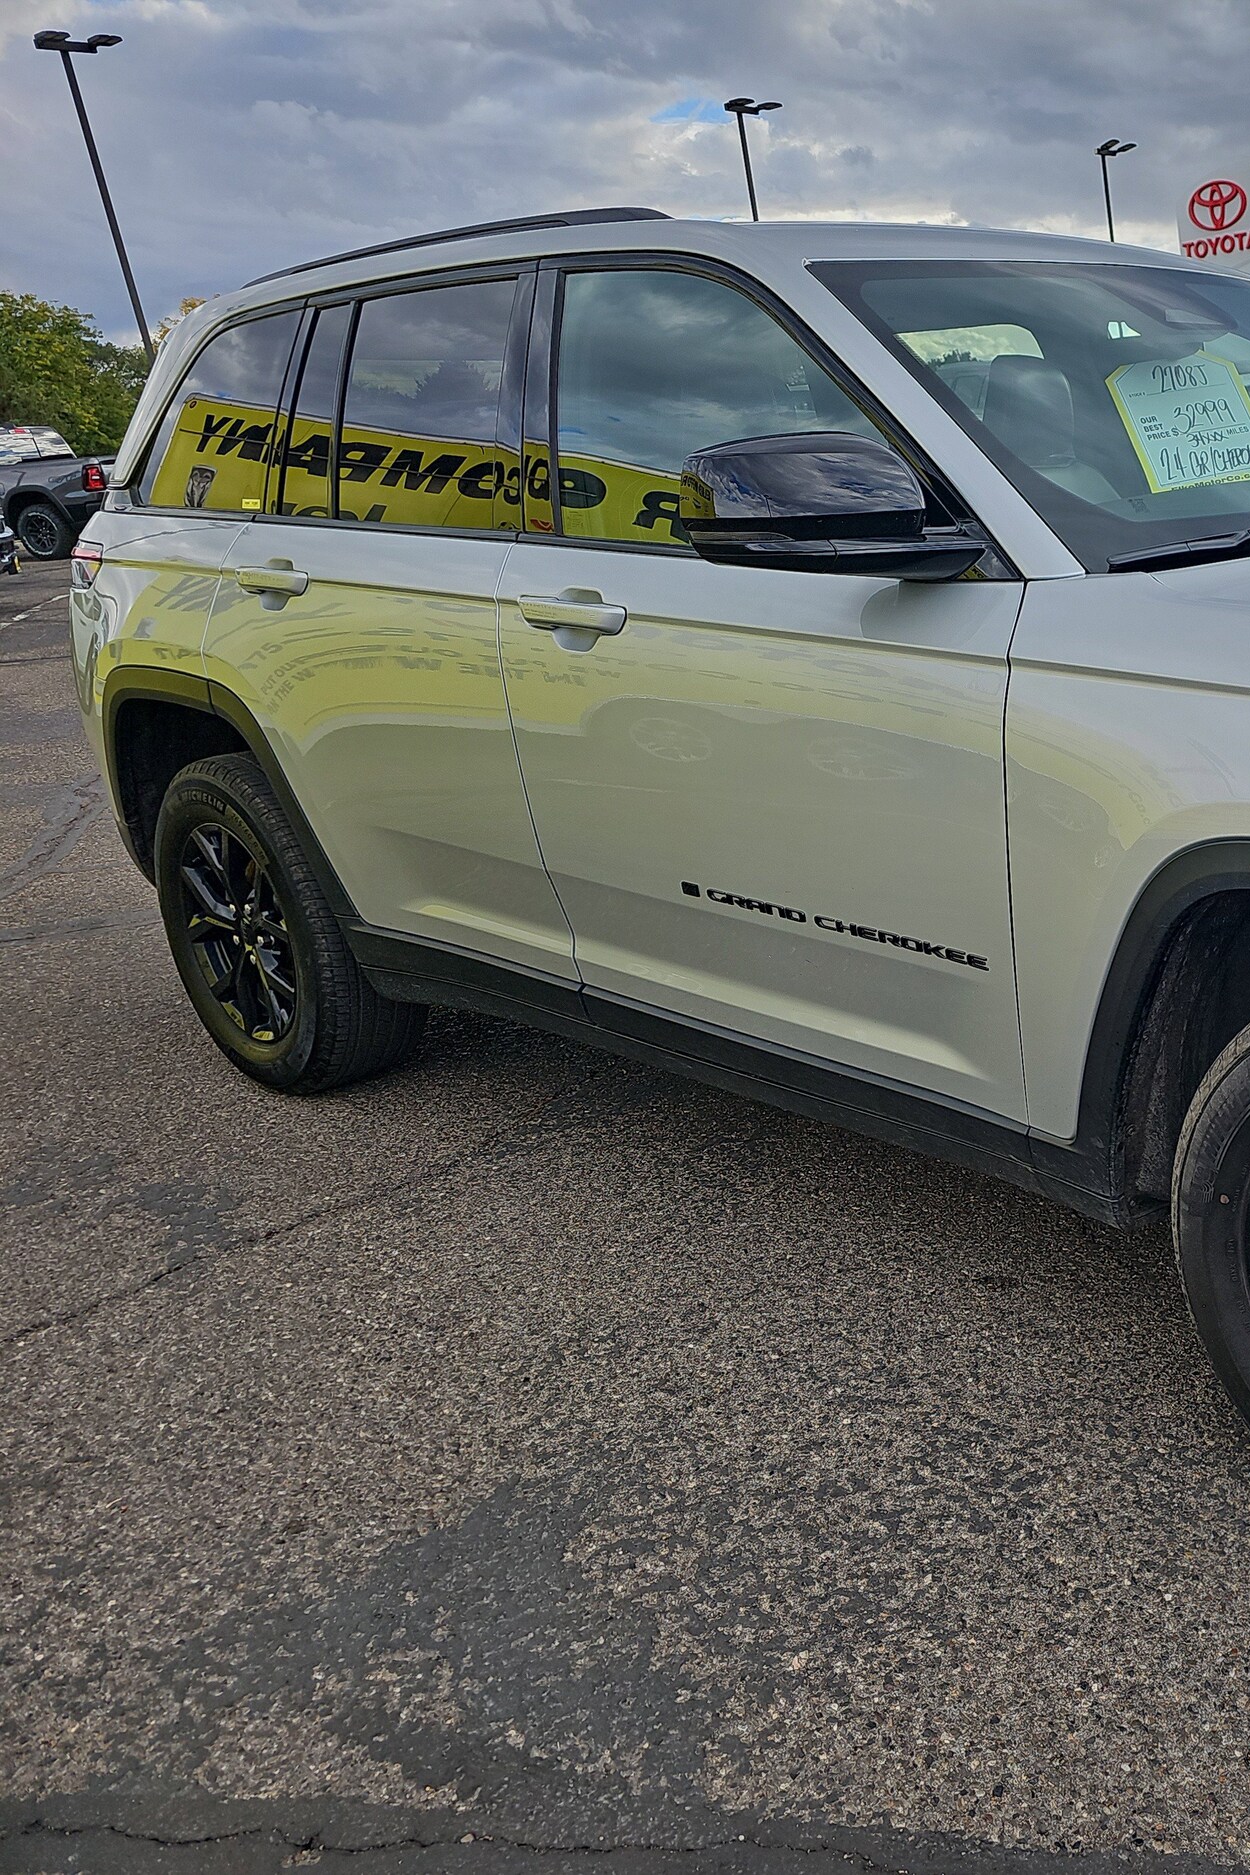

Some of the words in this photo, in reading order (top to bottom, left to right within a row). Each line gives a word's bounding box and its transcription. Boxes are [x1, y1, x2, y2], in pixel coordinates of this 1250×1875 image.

[1140, 415, 1158, 424] OUR
[1143, 423, 1164, 432] BEST
[1226, 426, 1249, 436] MILES
[1146, 430, 1171, 441] PRICE
[1160, 447, 1187, 481] 24
[706, 888, 807, 923] GRAND
[814, 914, 990, 972] CHEROKEE
